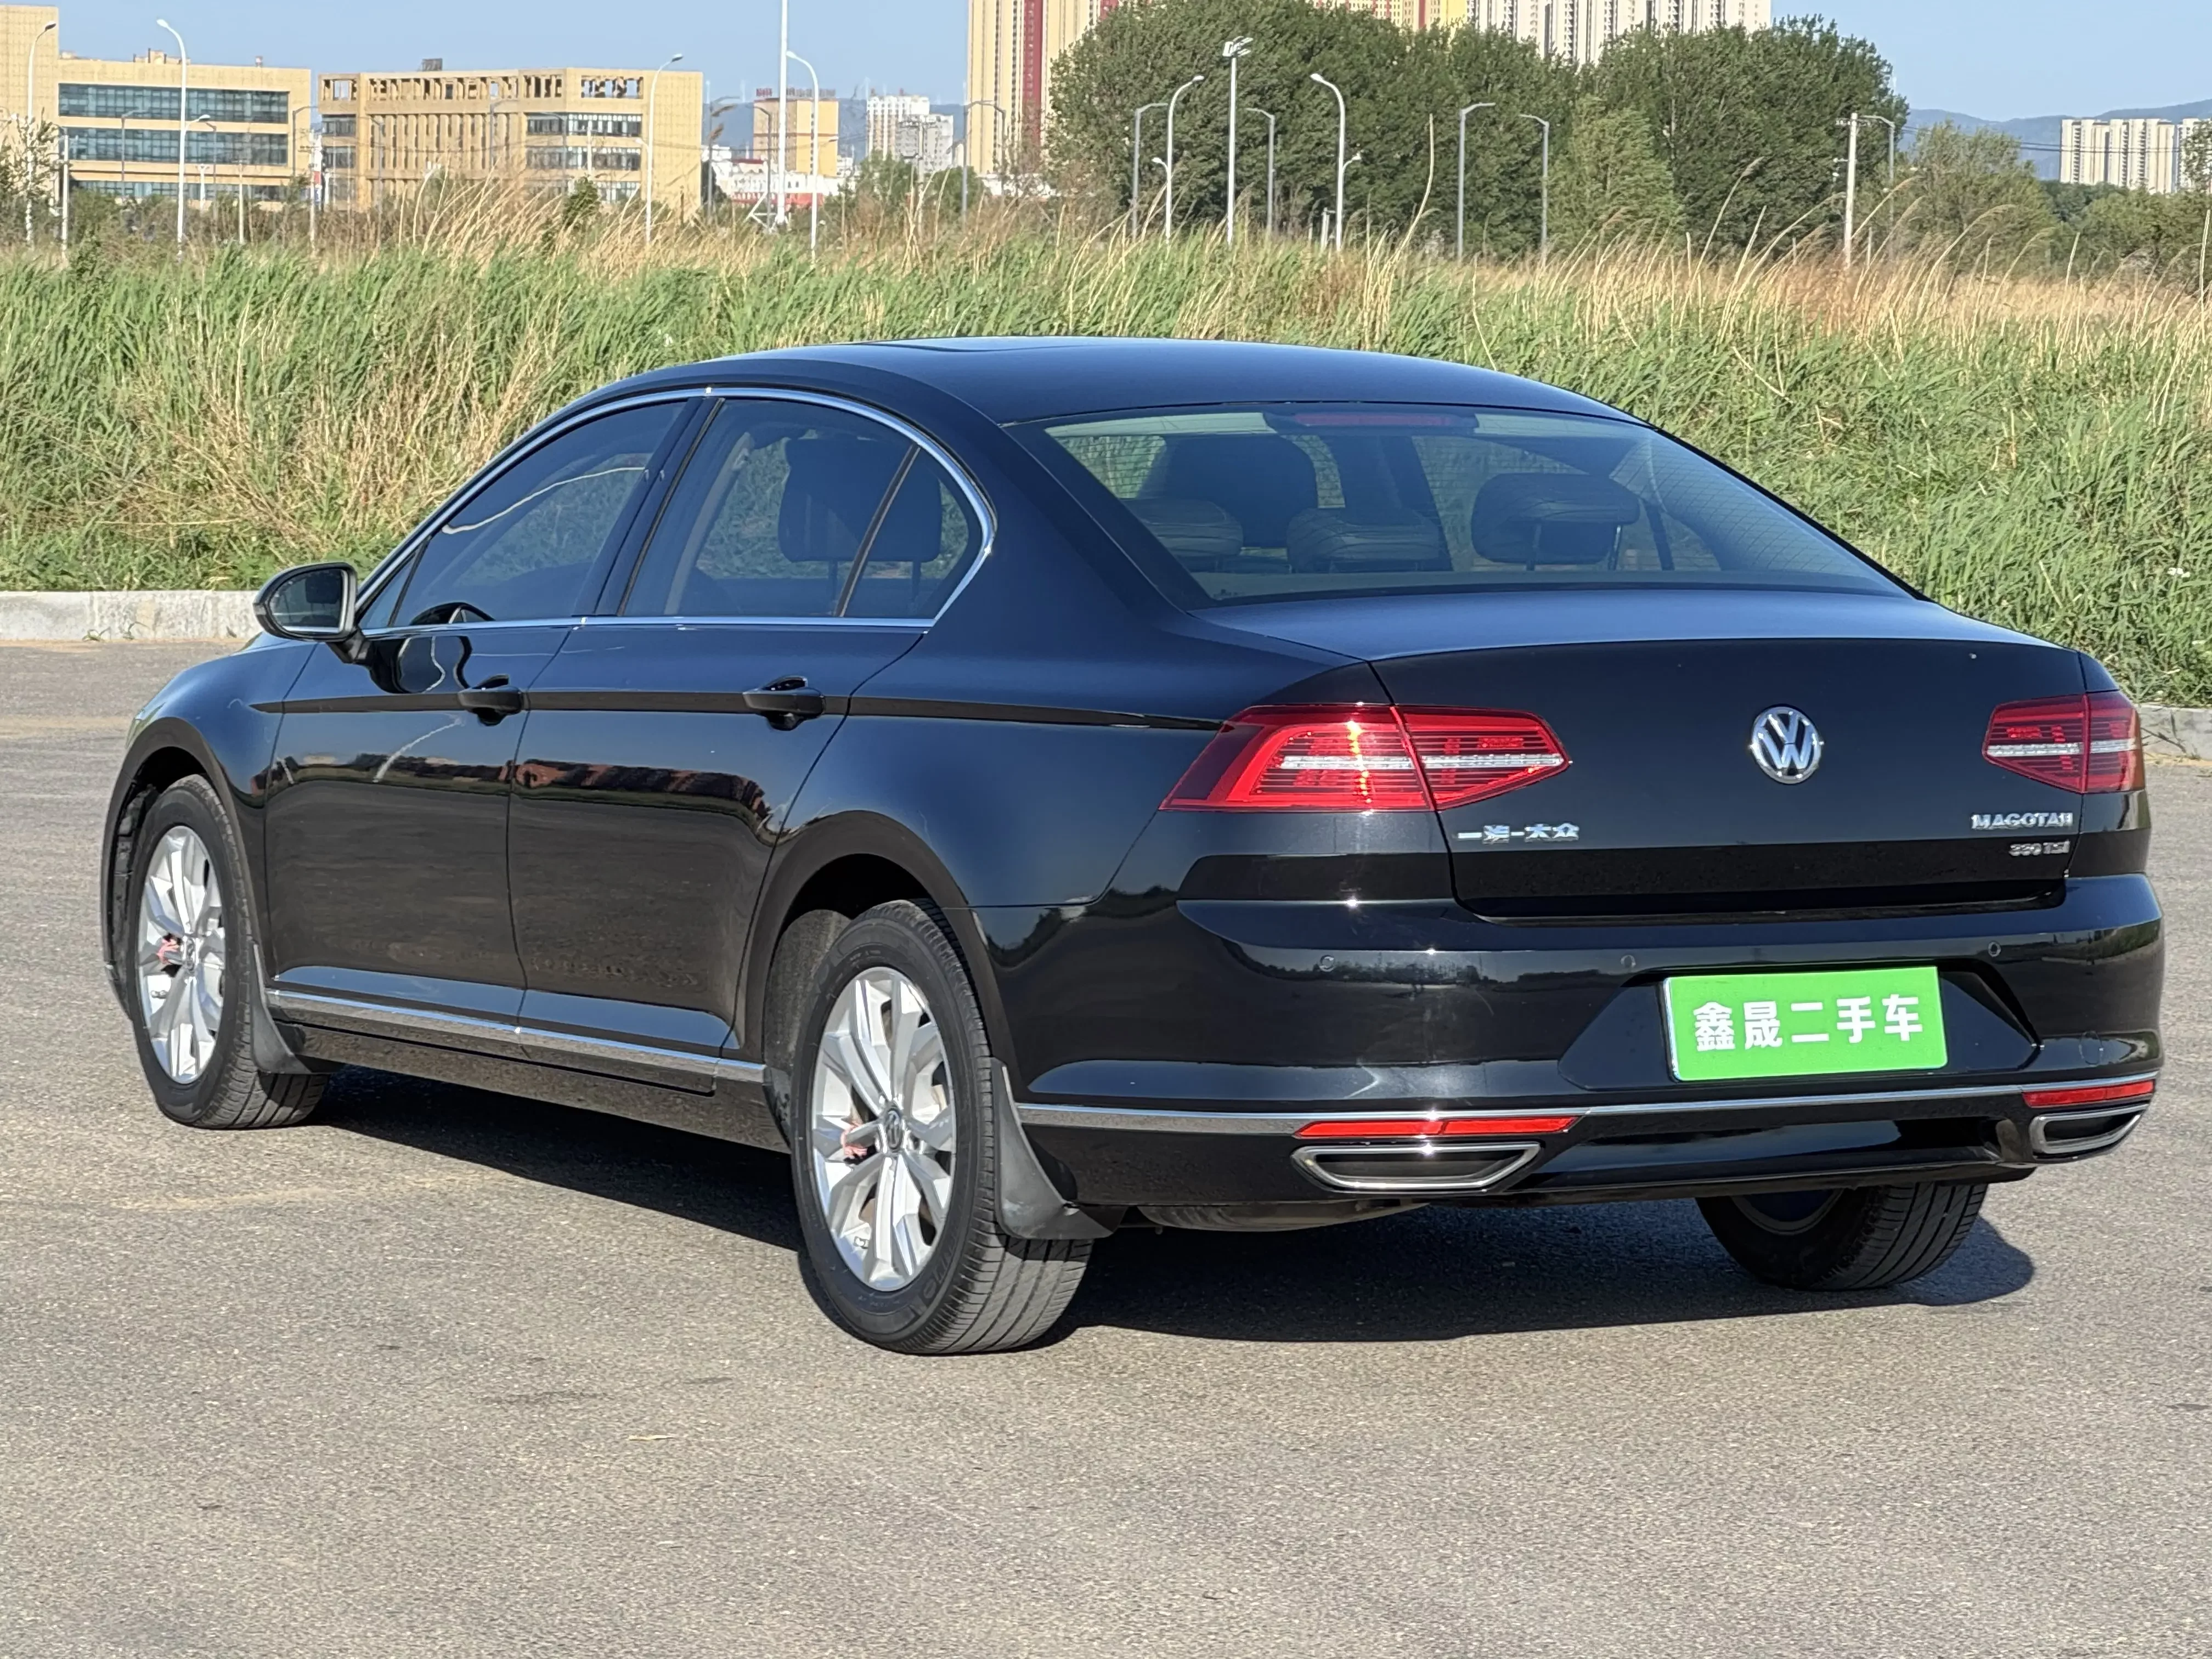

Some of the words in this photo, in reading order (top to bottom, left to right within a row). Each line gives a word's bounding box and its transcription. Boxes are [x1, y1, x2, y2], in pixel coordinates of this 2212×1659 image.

[1971, 812, 2073, 830] MAGOTAN
[1693, 994, 1923, 1052] 鑫晟二手车
